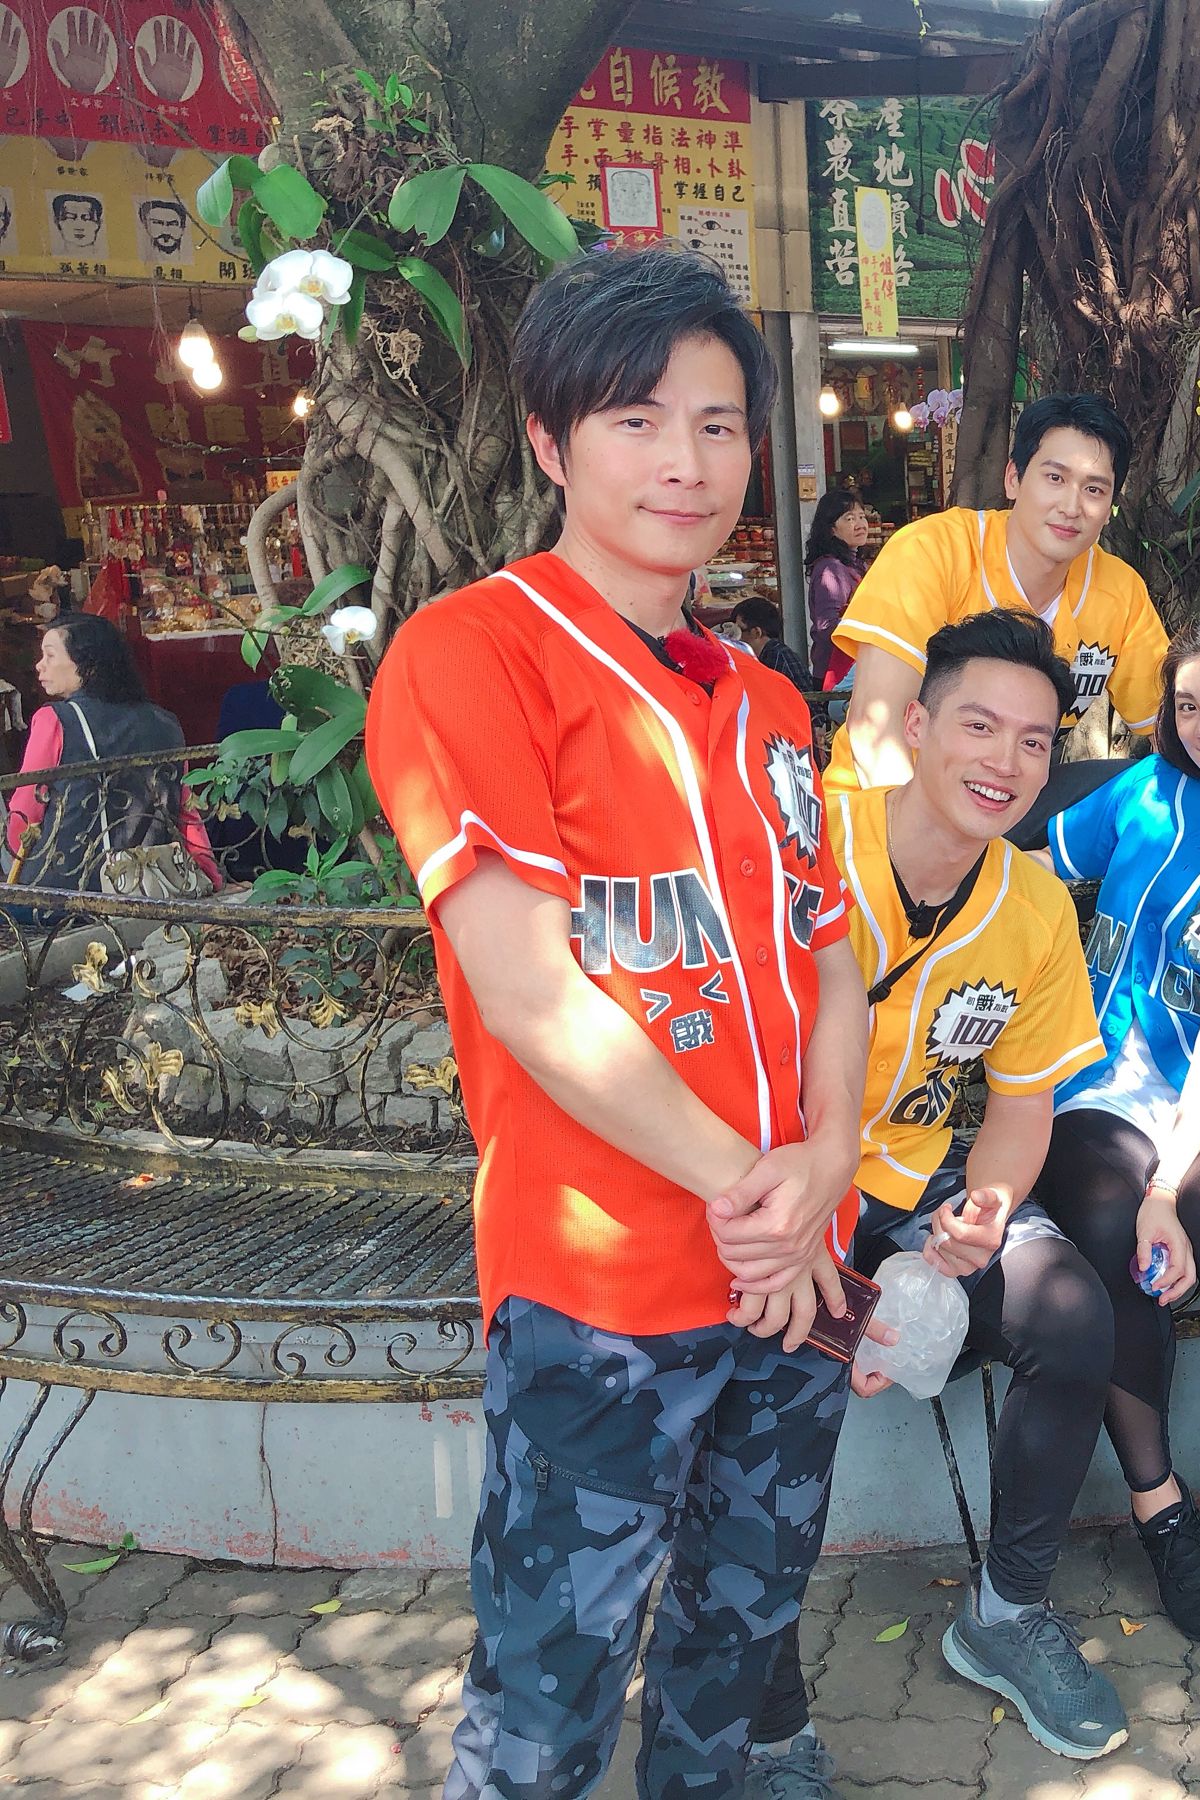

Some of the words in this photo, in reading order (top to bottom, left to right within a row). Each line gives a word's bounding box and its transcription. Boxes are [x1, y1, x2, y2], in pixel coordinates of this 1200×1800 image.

[559, 115, 744, 153] 手掌量指法神準
[949, 1014, 1007, 1046] 100
